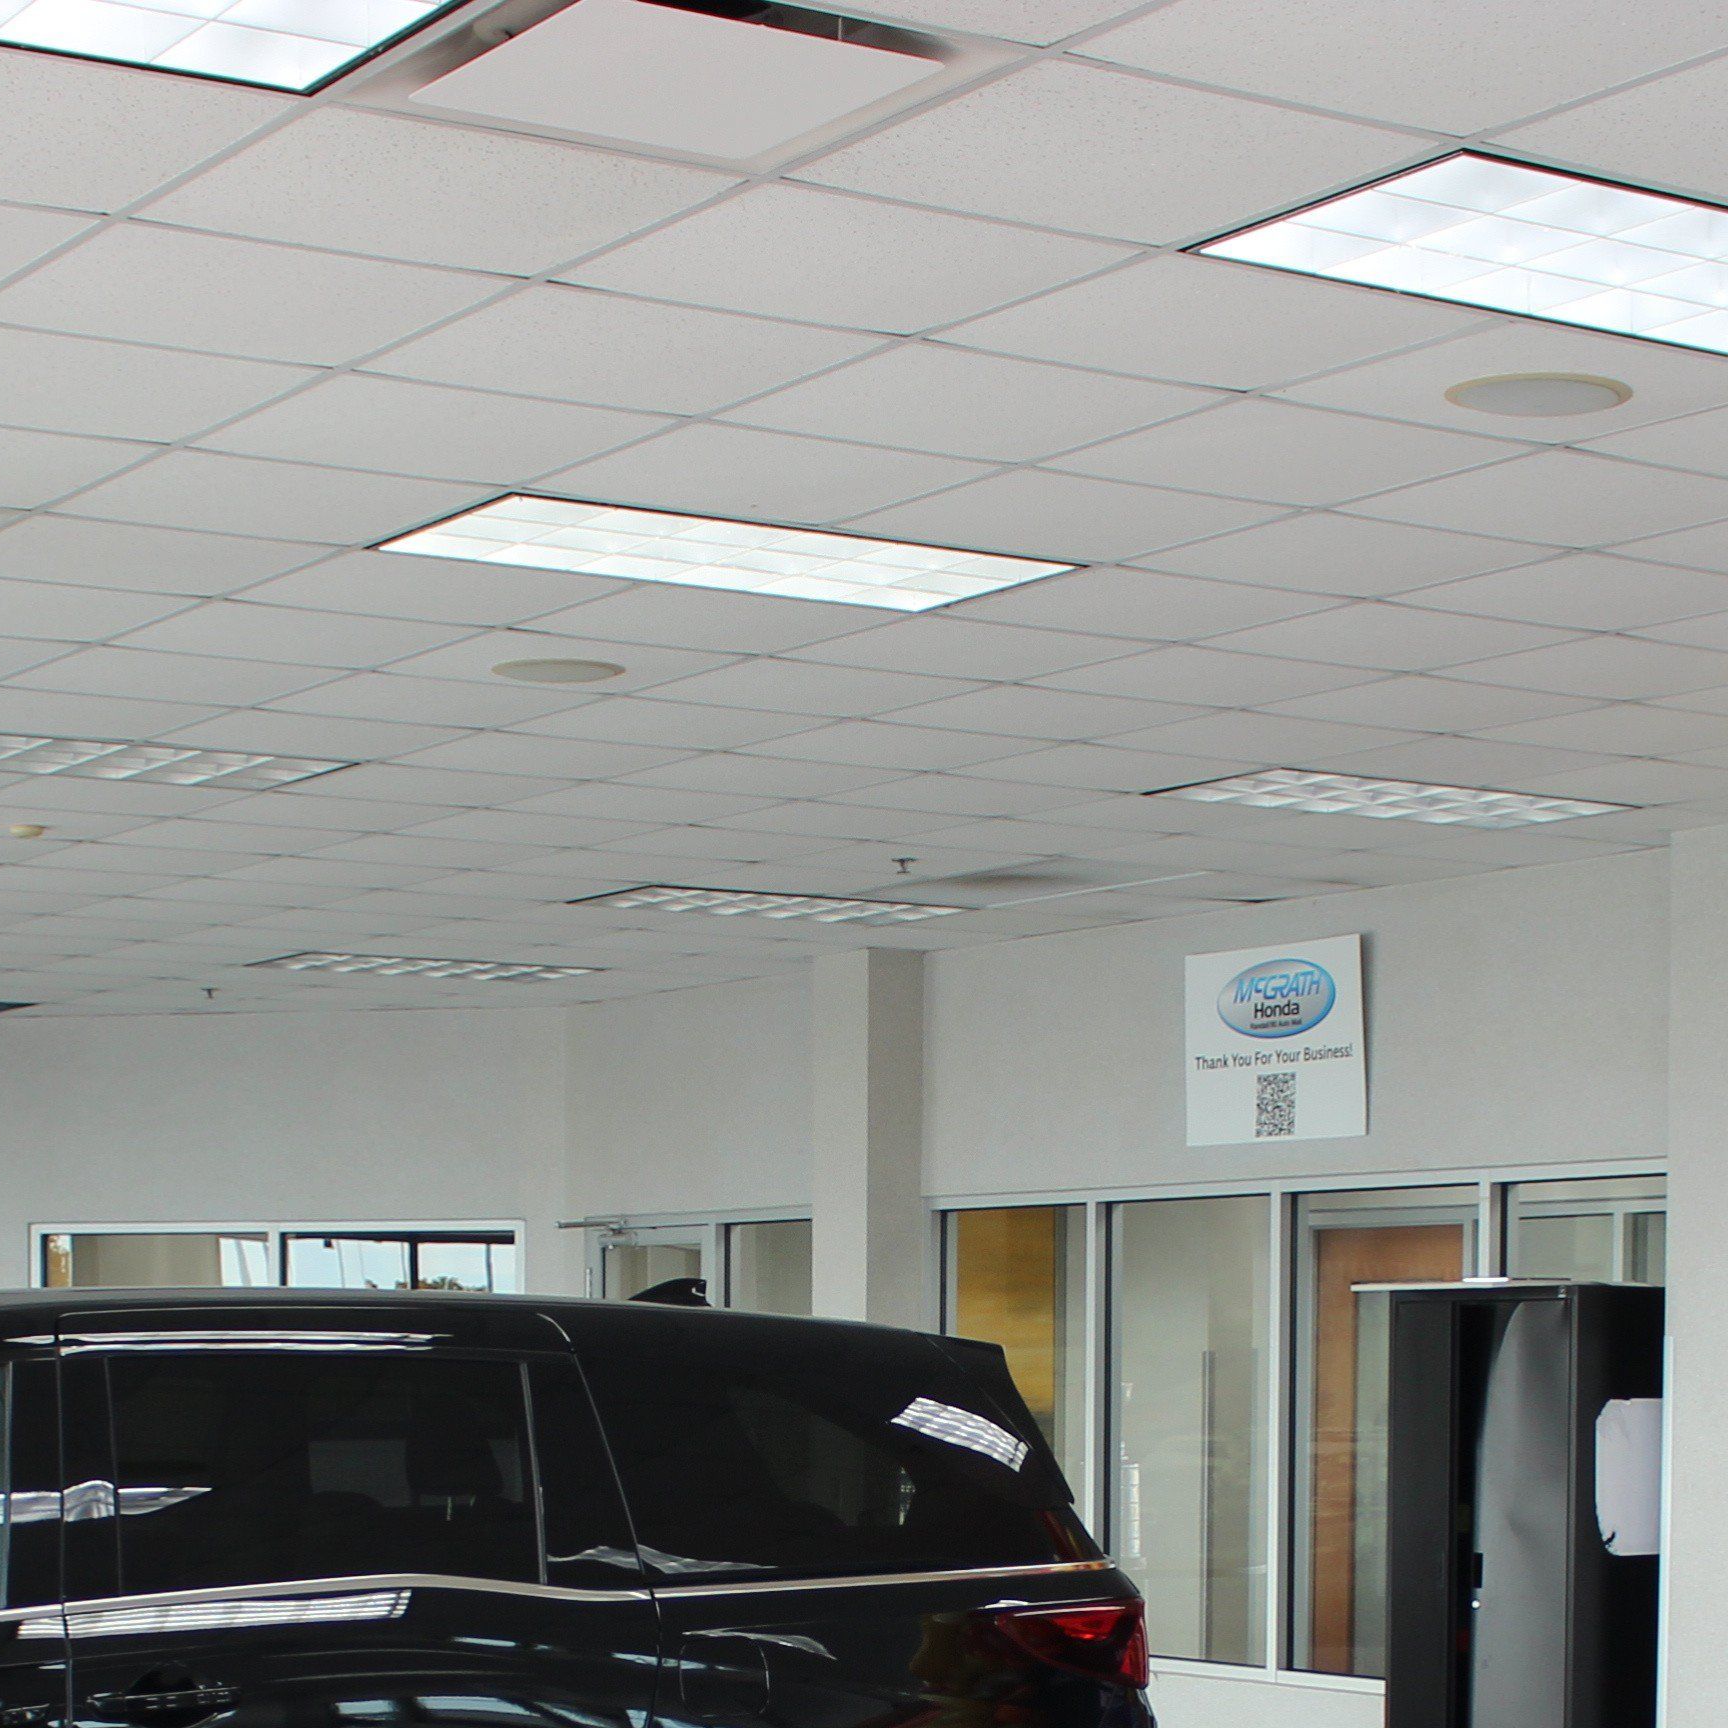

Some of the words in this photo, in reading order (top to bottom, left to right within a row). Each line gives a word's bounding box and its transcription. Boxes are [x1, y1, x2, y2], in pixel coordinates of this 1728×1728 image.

[1254, 999, 1300, 1019] Honda
[1195, 1055, 1229, 1070] Thank
[1232, 1052, 1252, 1067] You
[1254, 1050, 1273, 1065] For
[1275, 1048, 1301, 1063] Your
[1304, 1043, 1353, 1062] Business!
